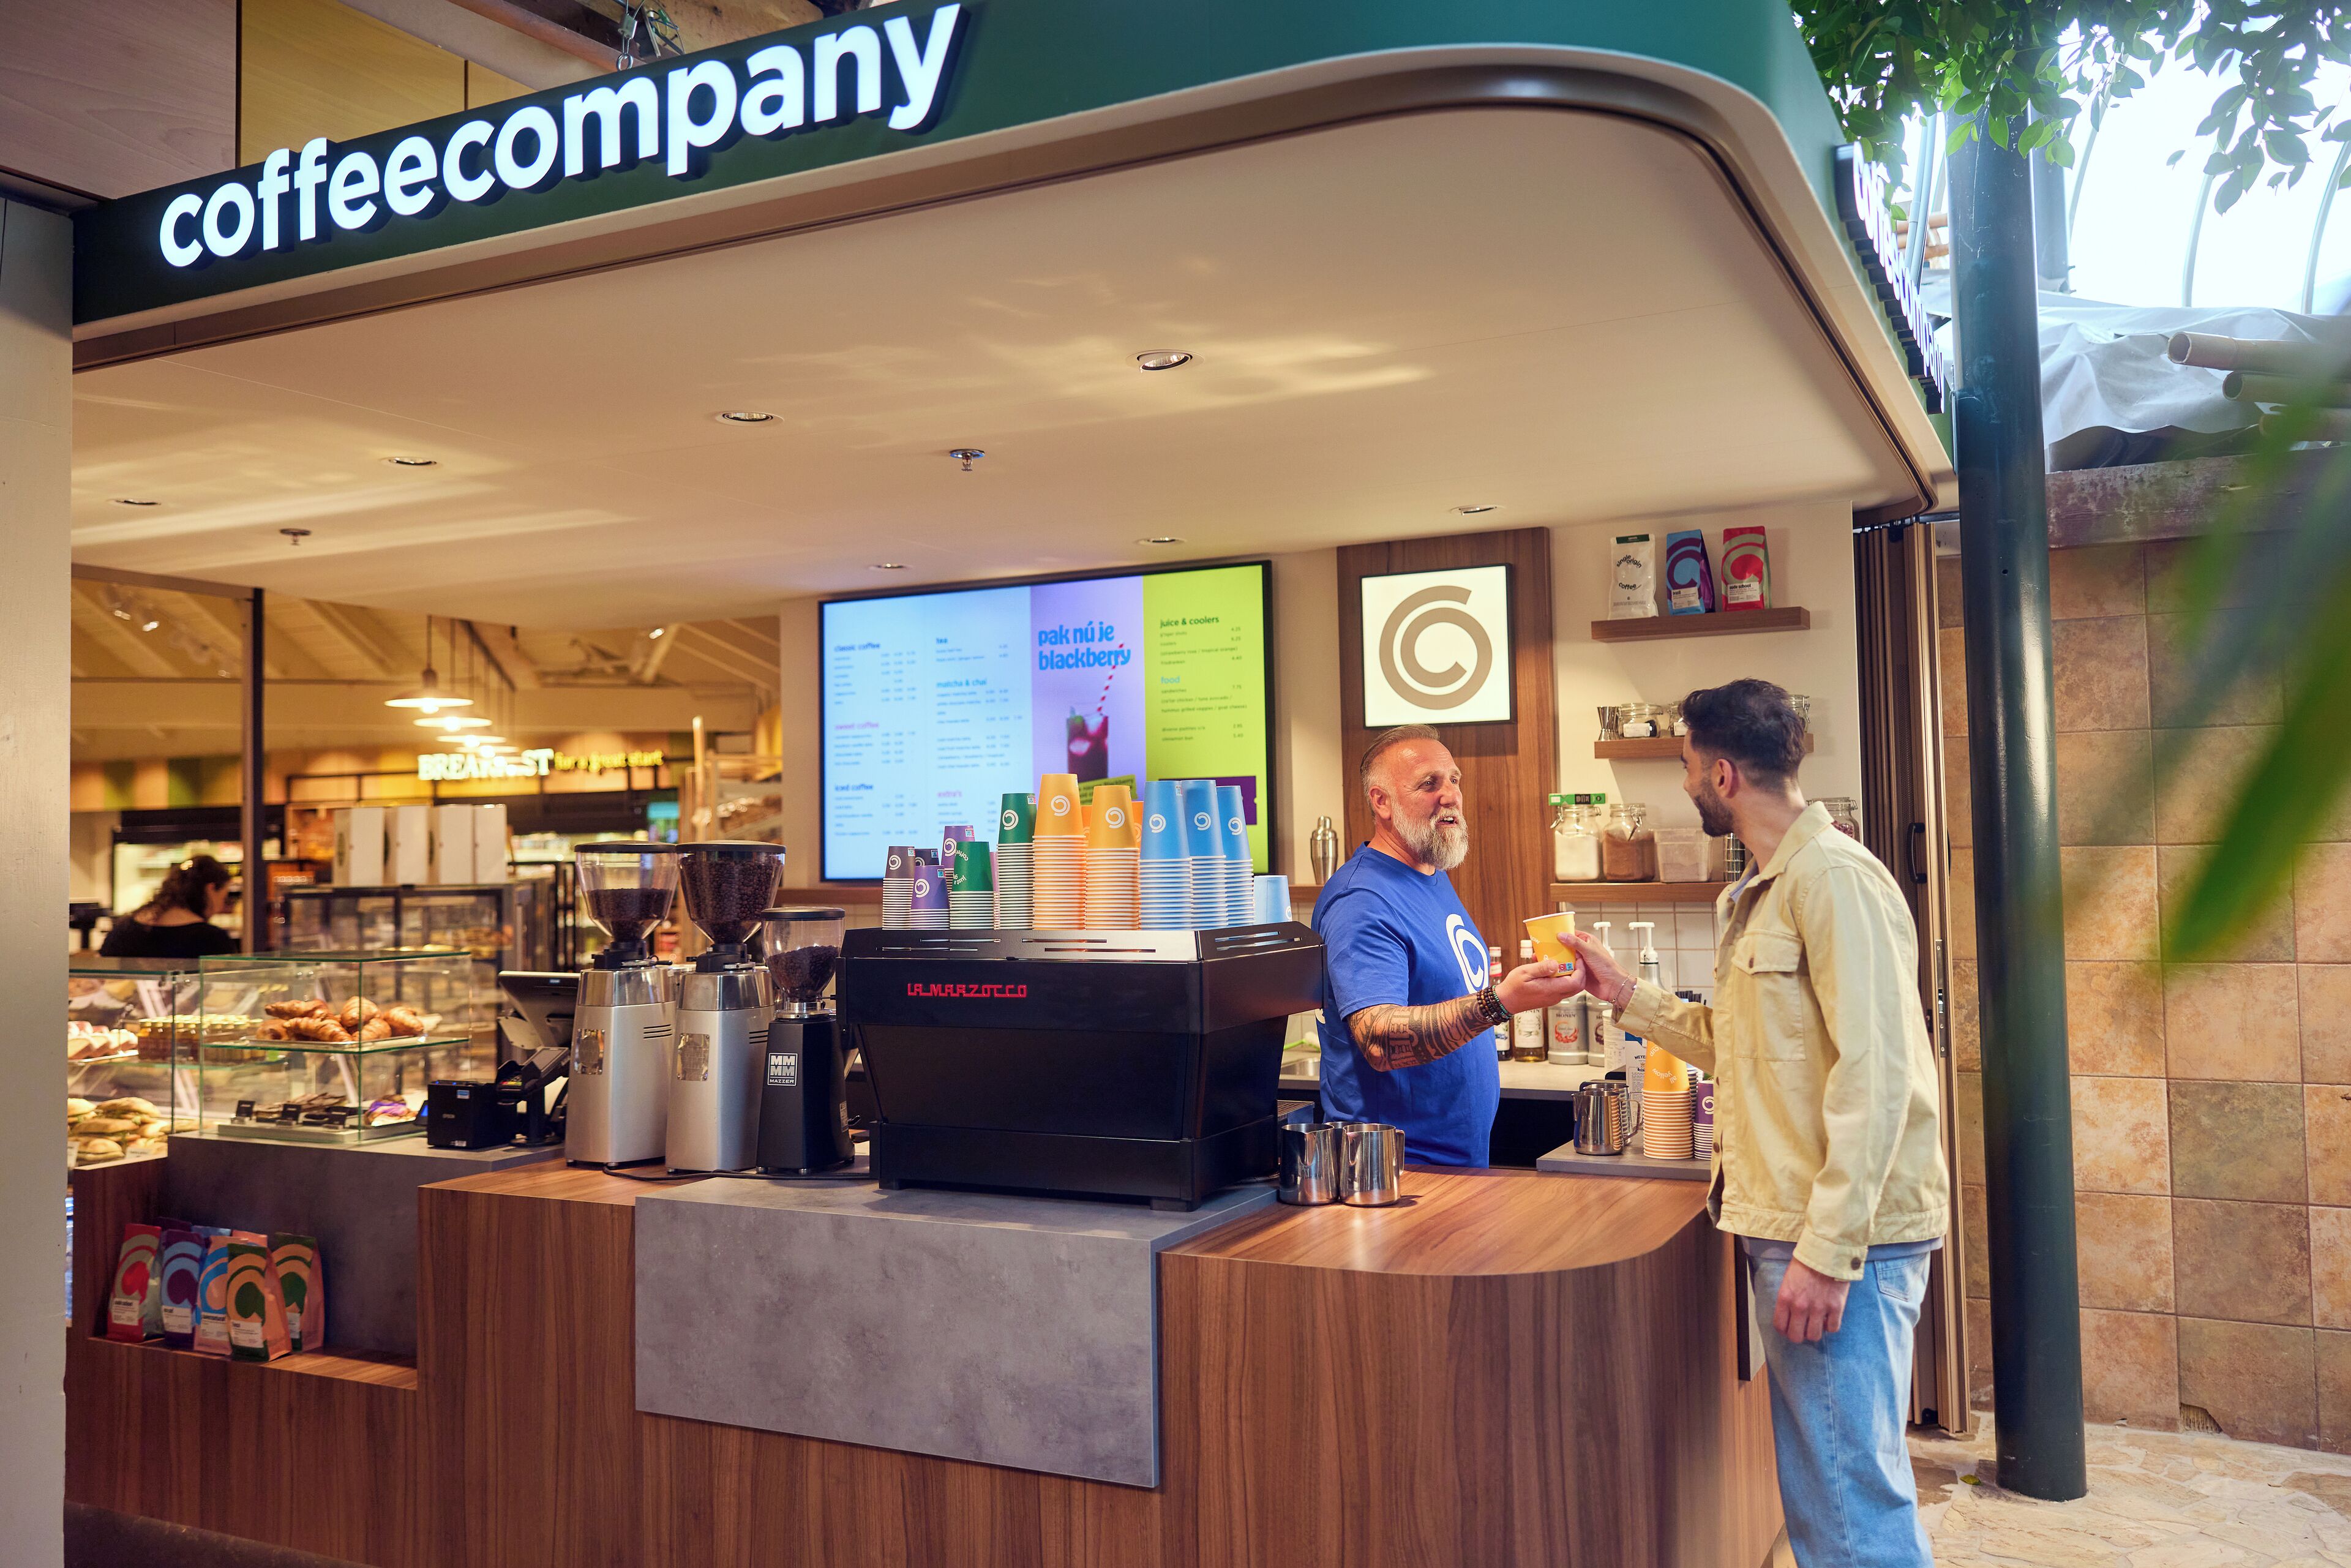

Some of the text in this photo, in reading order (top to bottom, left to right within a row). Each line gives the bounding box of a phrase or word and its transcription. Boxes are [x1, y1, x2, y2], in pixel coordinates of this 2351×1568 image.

[159, 2, 961, 268] coffeecompany
[1616, 554, 1642, 568] single origin
[1618, 582, 1637, 590] coffee
[1160, 618, 1179, 629] juice
[1189, 615, 1220, 625] coolers
[1038, 620, 1114, 647] pak nú je
[1038, 647, 1131, 670] blackberry
[1160, 676, 1181, 685] food
[907, 983, 1027, 999] LA MARZOCCO
[1652, 1068, 1673, 1079] yellow
